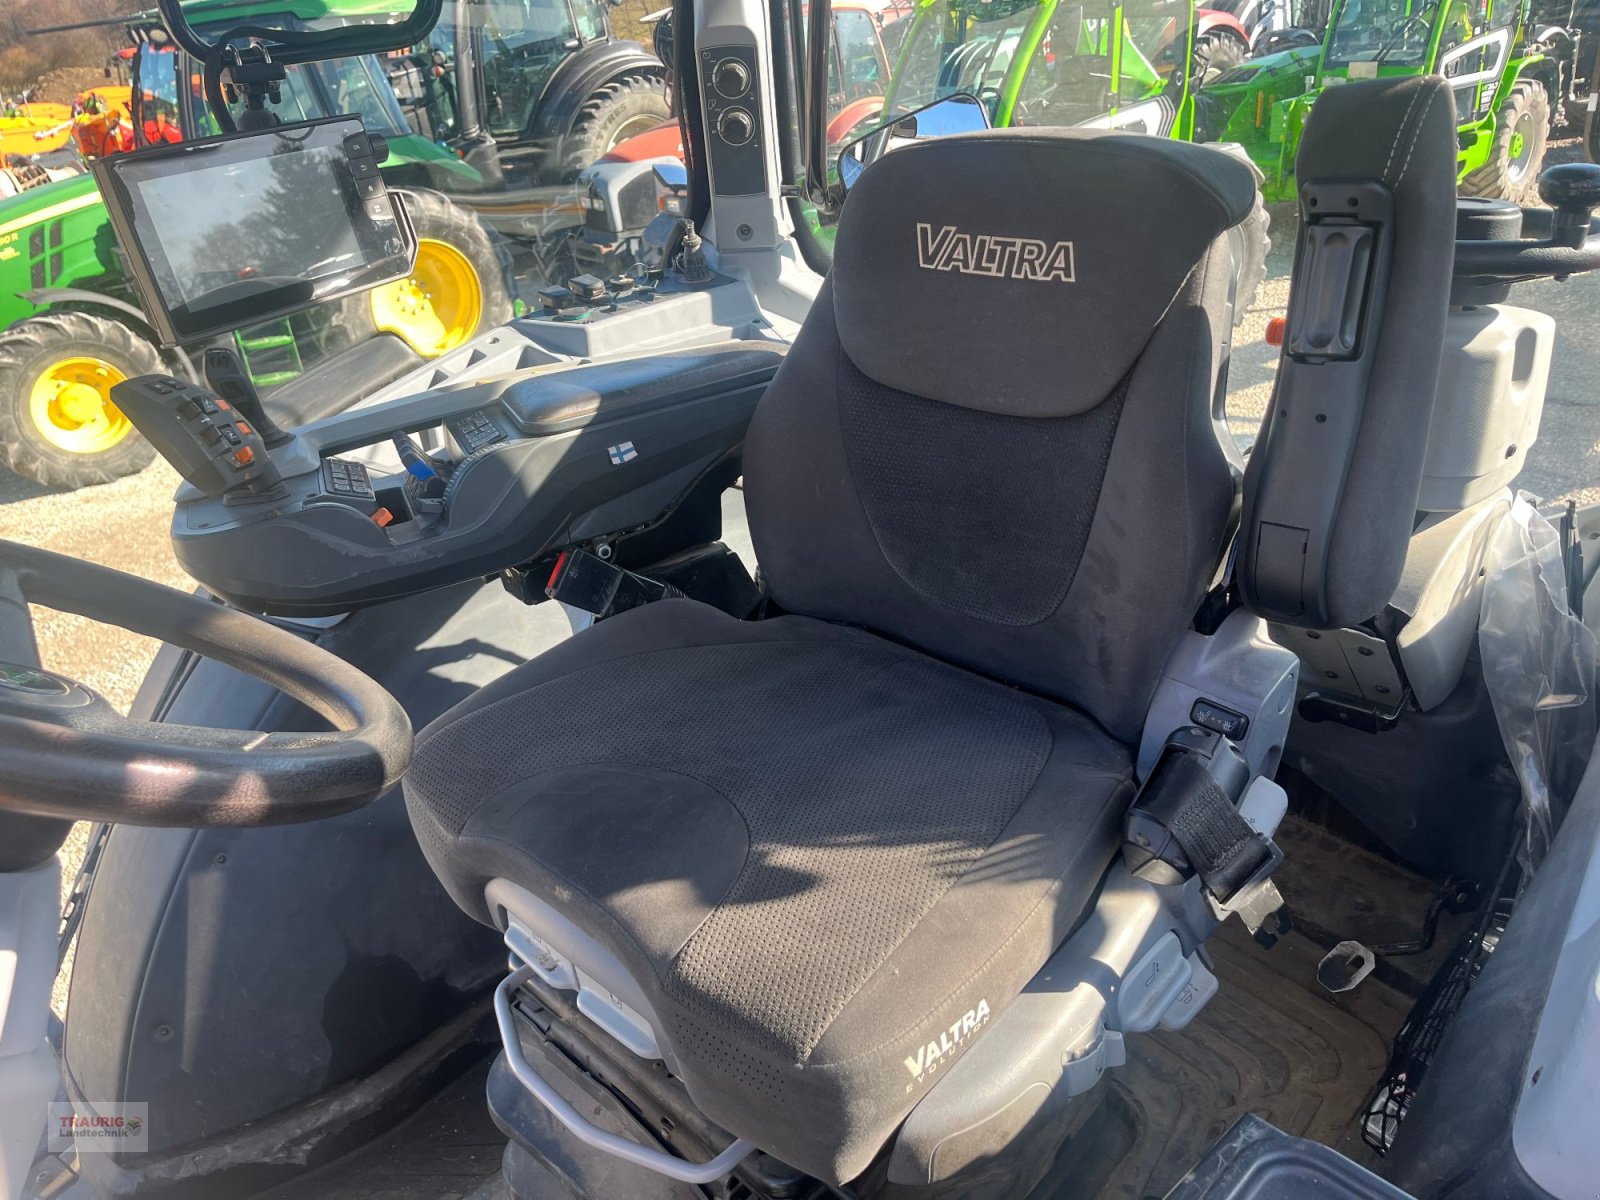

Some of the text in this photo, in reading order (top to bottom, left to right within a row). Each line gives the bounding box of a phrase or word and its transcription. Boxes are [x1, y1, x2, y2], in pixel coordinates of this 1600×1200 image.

[917, 223, 1076, 282] VALTRA
[903, 998, 990, 1079] VALTRA
[905, 1013, 990, 1094] EVOLUTION
